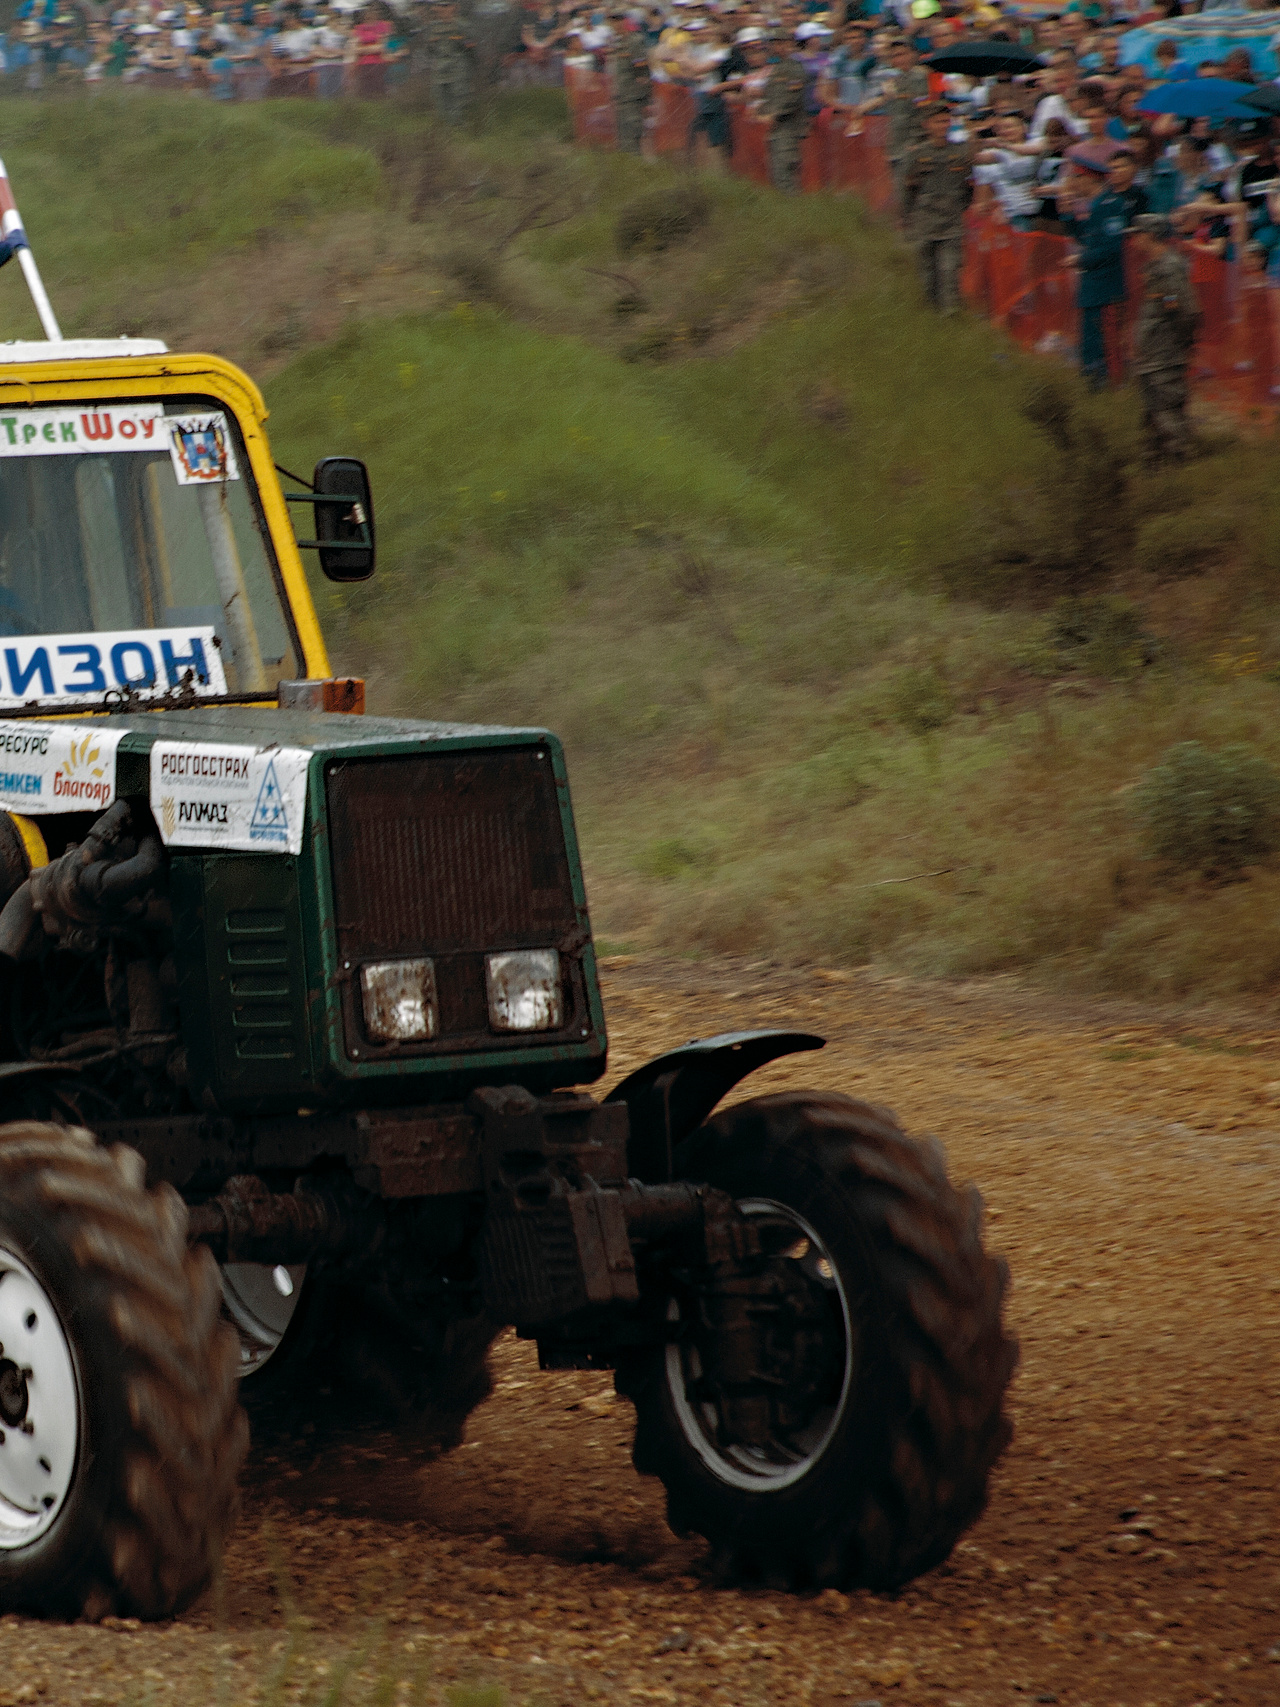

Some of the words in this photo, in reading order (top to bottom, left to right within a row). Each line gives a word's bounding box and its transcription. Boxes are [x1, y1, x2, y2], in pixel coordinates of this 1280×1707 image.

[161, 754, 249, 779] РОСГОССТРАХ
[54, 771, 111, 806] Благояр
[179, 802, 228, 823] АЛМАЗ
